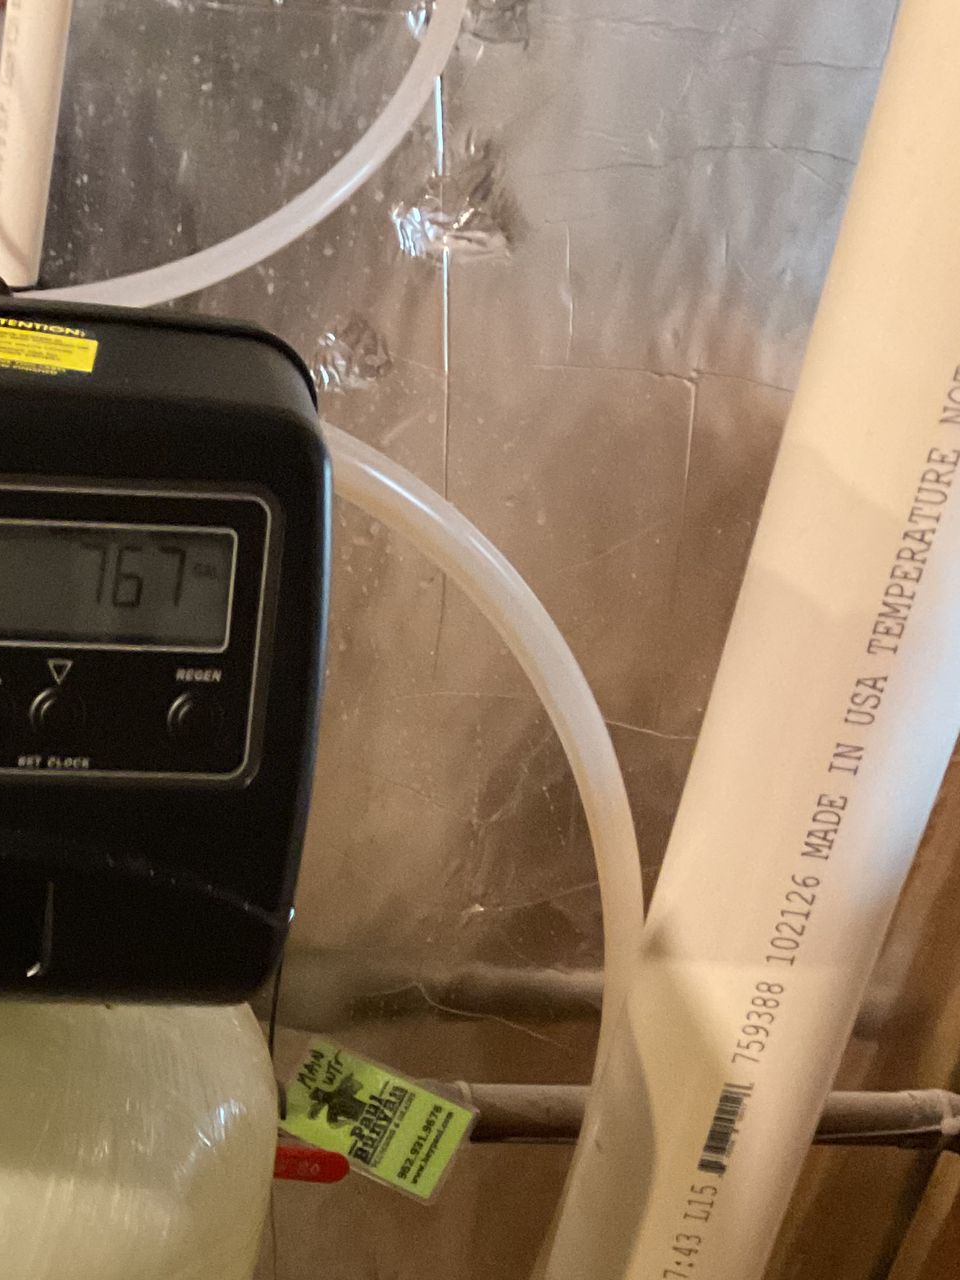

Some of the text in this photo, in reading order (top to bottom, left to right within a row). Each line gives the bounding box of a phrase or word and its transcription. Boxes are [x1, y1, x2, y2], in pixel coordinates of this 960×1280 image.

[81, 541, 187, 607] 767
[867, 446, 960, 658] TEMPERATURE
[176, 668, 223, 683] REGEN
[844, 674, 889, 728] USA
[17, 756, 90, 770] SET CLOCK
[828, 742, 866, 777] IN
[801, 793, 849, 862] MADE
[766, 873, 821, 967] 102126
[731, 980, 786, 1065] 759388
[350, 1094, 384, 1141] Paul
[353, 1085, 408, 1165] Bunyan
[682, 1183, 719, 1223] L15
